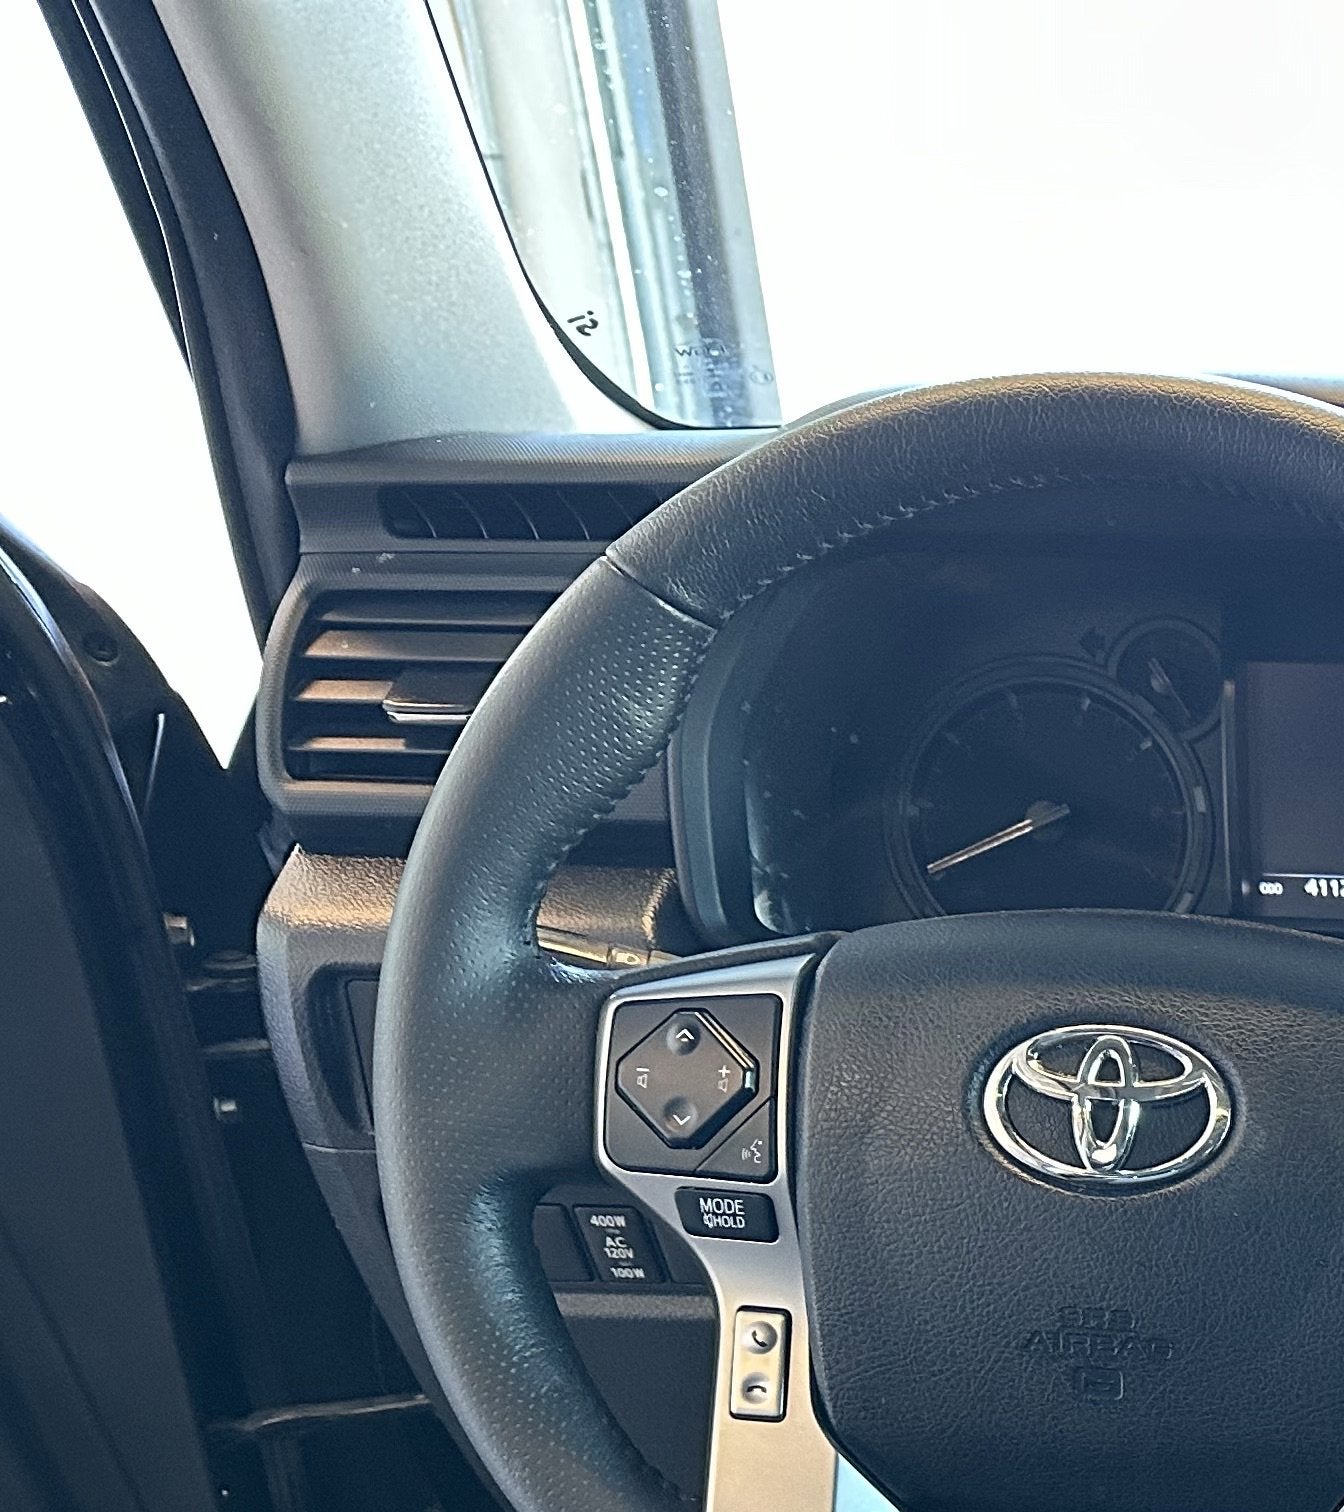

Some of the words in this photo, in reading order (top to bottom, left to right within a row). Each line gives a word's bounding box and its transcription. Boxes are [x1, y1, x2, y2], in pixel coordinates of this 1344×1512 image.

[699, 1198, 745, 1215] MODE
[590, 1214, 626, 1228] 400W
[713, 1216, 746, 1229] HOLD
[605, 1236, 628, 1248] AC
[604, 1247, 634, 1260] 120V
[610, 1267, 645, 1279] 100W
